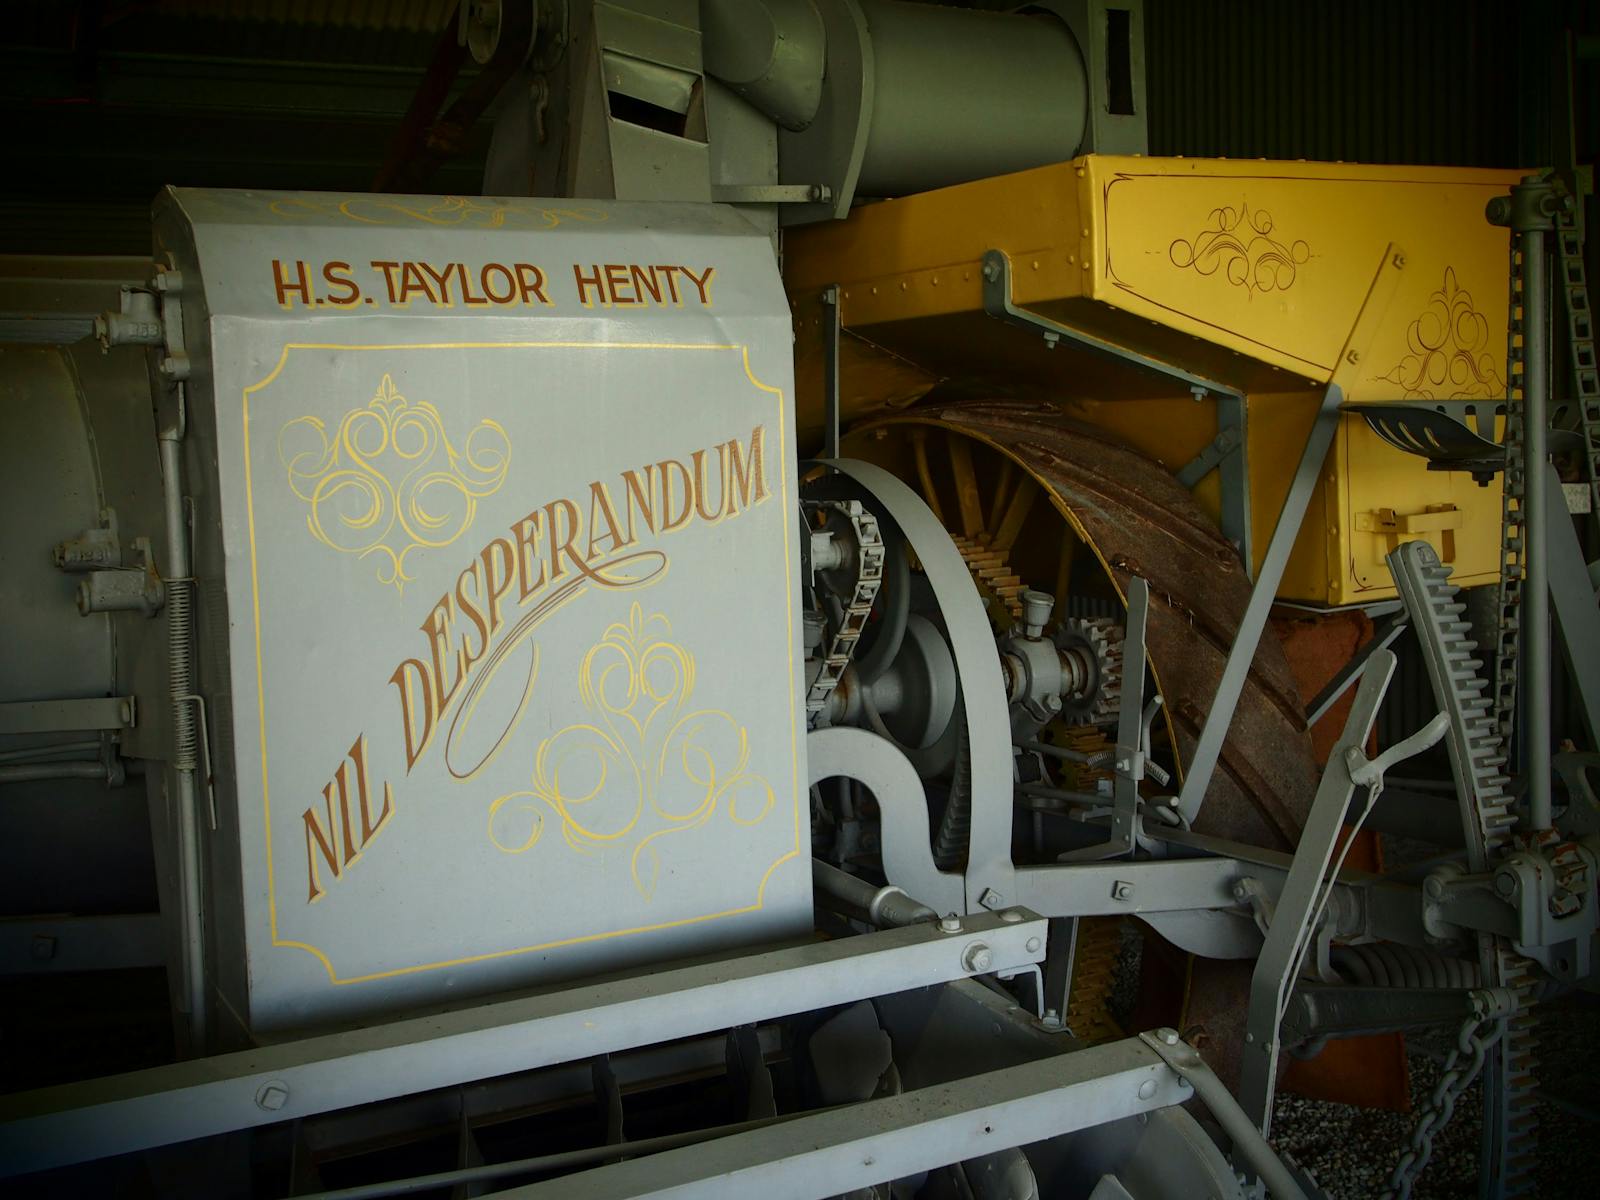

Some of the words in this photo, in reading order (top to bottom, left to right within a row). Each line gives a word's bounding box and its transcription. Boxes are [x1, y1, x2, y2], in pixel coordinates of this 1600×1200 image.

[573, 263, 715, 310] HENTY
[301, 732, 395, 905] NIL
[388, 424, 774, 780] DESPERANDUM
